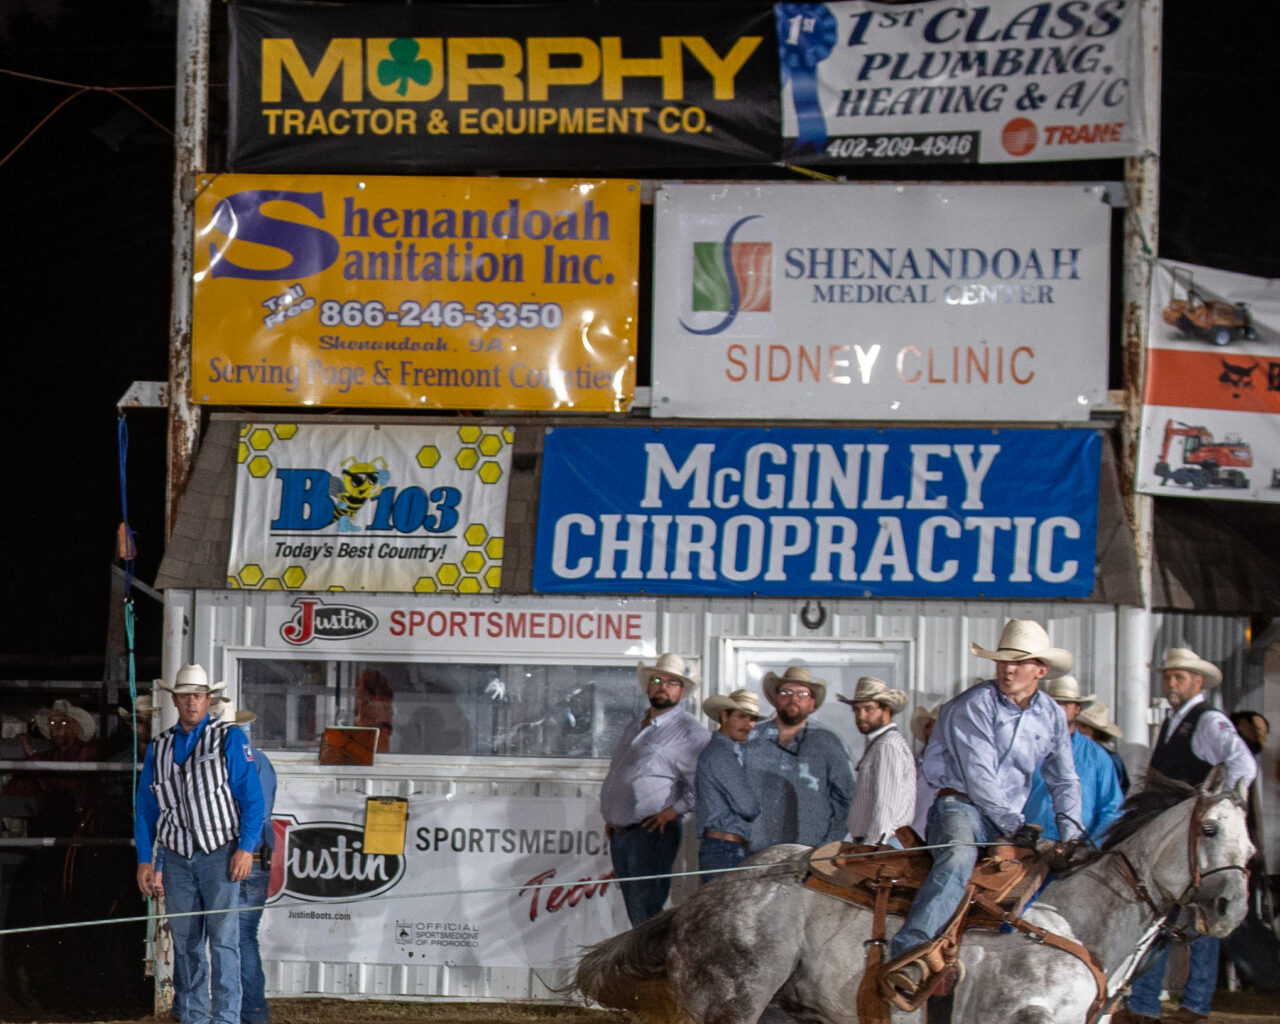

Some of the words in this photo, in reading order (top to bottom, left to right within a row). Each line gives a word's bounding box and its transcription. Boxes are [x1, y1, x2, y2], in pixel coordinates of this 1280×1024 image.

[923, 0, 1126, 44] CLASS
[261, 36, 764, 102] MURPHY
[836, 84, 1008, 117] HEATING
[1015, 82, 1047, 111] &
[1055, 77, 1129, 117] A/C
[263, 108, 417, 136] TRACTOR
[427, 108, 450, 135] &
[459, 107, 651, 135] EQUIPMENT
[658, 107, 714, 135] CO.
[1043, 122, 1126, 146] TRANE
[826, 135, 972, 159] 402-209-4846
[542, 244, 616, 286] Inc.
[784, 247, 1083, 281] SHENANDOAH
[812, 284, 936, 305] MEDICAL
[944, 283, 1056, 306] CENTER
[320, 300, 564, 330] 866-246-3350
[208, 356, 300, 393] Serving
[307, 359, 365, 394] Page
[372, 359, 392, 386] &
[399, 360, 502, 388] Fremont
[725, 343, 881, 385] SIDNEY
[896, 345, 1036, 386] CLINIC
[366, 485, 463, 534] 103
[274, 541, 333, 560] Today's
[336, 542, 373, 559] Best
[377, 543, 447, 563] Country!
[550, 513, 1082, 584] CHIROPRACTIC
[283, 600, 370, 643] Justin
[389, 609, 643, 641] SPORTSMEDICINE
[288, 909, 352, 922] JustinBoots.com
[415, 922, 480, 932] OFFICIAL
